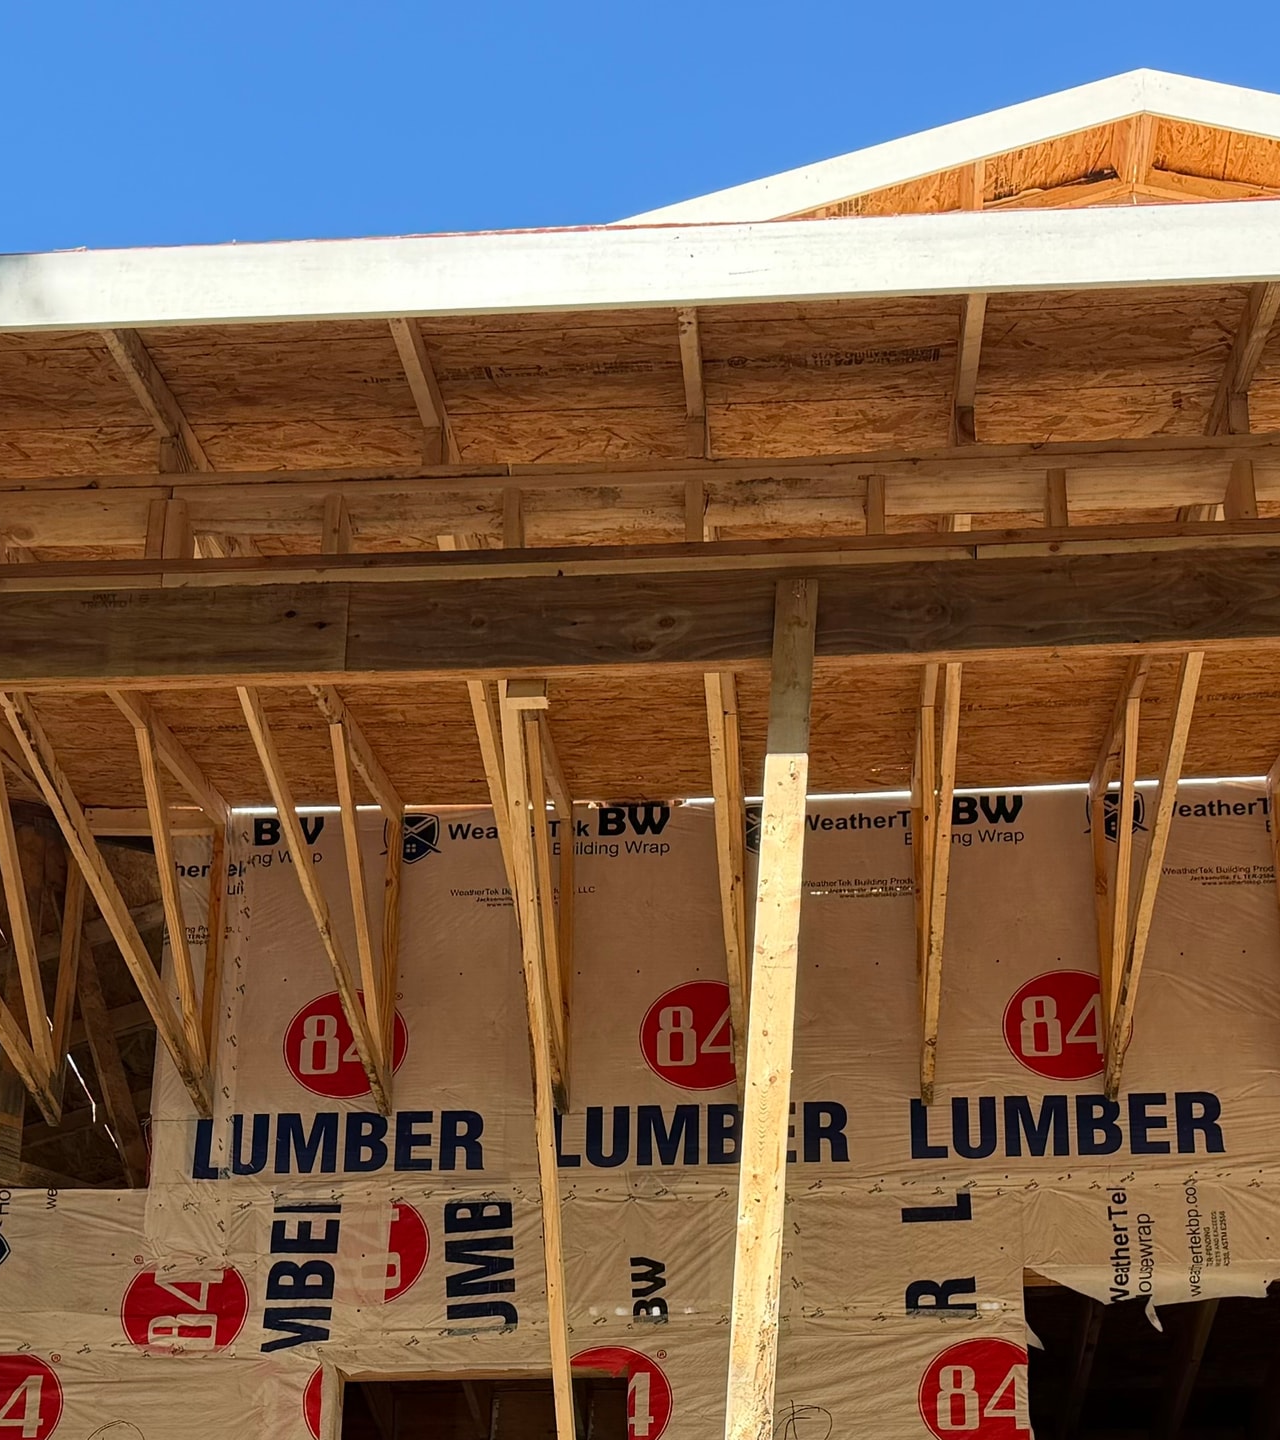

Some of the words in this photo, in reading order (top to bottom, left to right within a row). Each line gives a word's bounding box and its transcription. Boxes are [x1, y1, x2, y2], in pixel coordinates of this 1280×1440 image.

[598, 805, 671, 837] BW
[952, 795, 1023, 826] BW
[625, 841, 671, 857] Wrap
[978, 829, 1024, 845] Wrap
[191, 1109, 485, 1180] LUMBER
[909, 1091, 1226, 1160] LUMBER
[630, 1256, 668, 1323] BW
[936, 1364, 1028, 1431] 84
